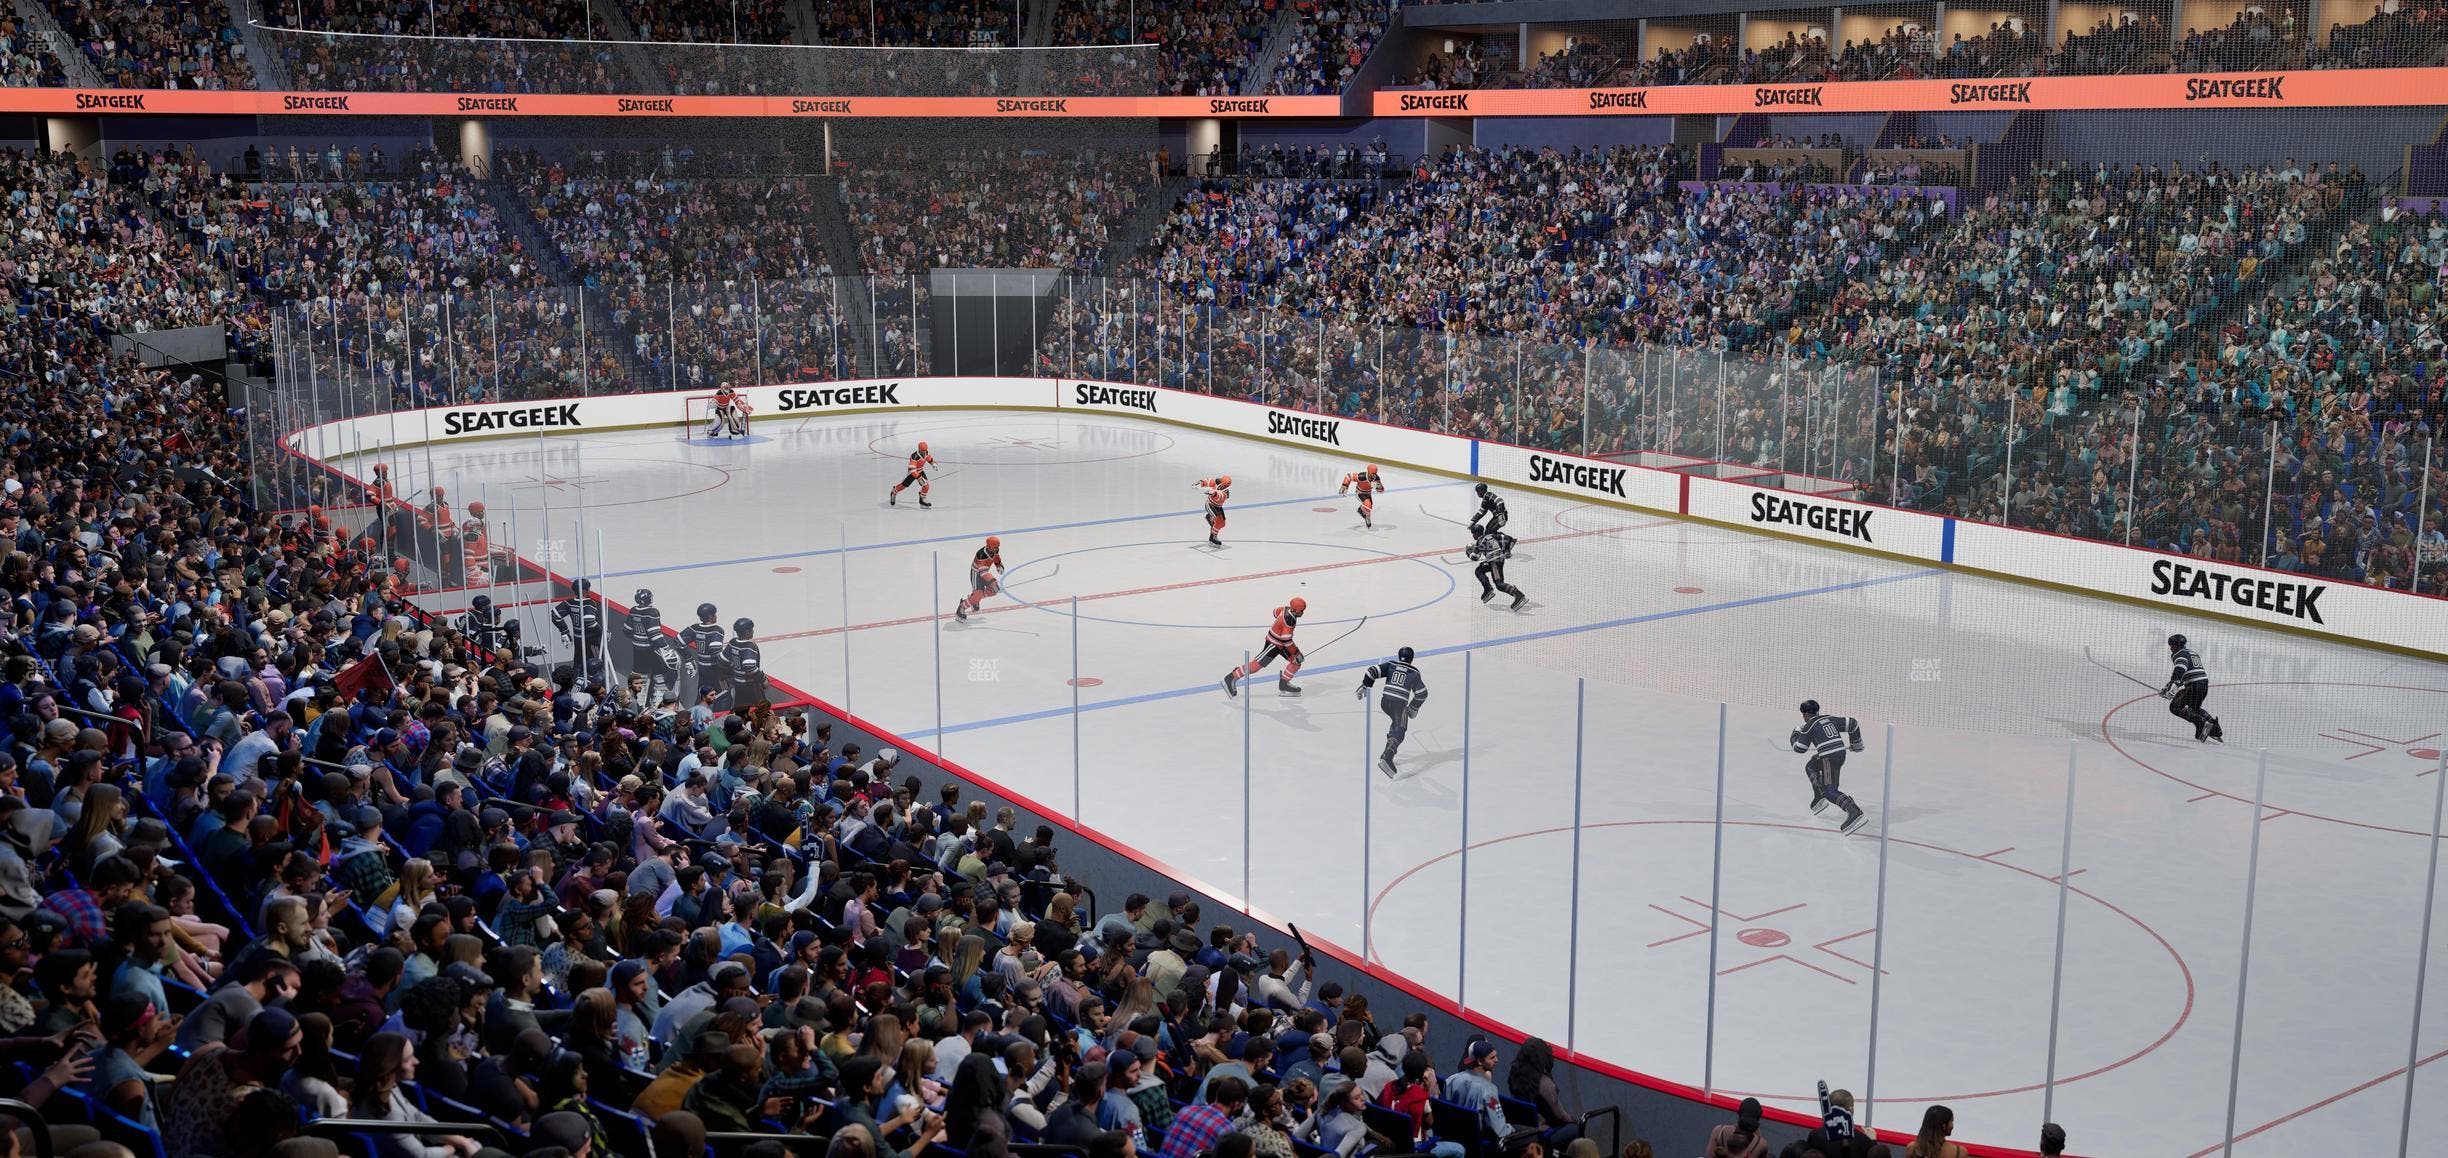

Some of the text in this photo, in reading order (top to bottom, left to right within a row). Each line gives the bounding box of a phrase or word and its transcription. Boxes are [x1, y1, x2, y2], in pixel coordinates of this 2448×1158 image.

[1755, 87, 1823, 106] SEATGEEK
[1951, 82, 2032, 103] SEATGEEK
[2186, 76, 2285, 100] SEATGEEK
[76, 94, 146, 109] SEATGEEK
[284, 96, 350, 110] SEATGEEK
[458, 97, 518, 111] SEATGEEK
[619, 99, 674, 112] SEATGEEK
[793, 101, 851, 113] SEATGEEK
[998, 100, 1067, 112] SEATGEEK
[1211, 100, 1269, 113] SEATGEEK
[1401, 94, 1469, 110] SEATGEEK
[1591, 91, 1647, 109] SEATGEEK
[779, 384, 900, 411] SEATGEEK
[1077, 384, 1157, 412] SEATGEEK
[445, 404, 582, 435] SEATGEEK
[1269, 411, 1340, 446] SEATGEEK
[1530, 455, 1627, 498] SEATGEEK
[1752, 493, 1874, 543] SEATGEEK
[2151, 560, 2327, 625] SEATGEEK
[1391, 670, 1407, 686] 00
